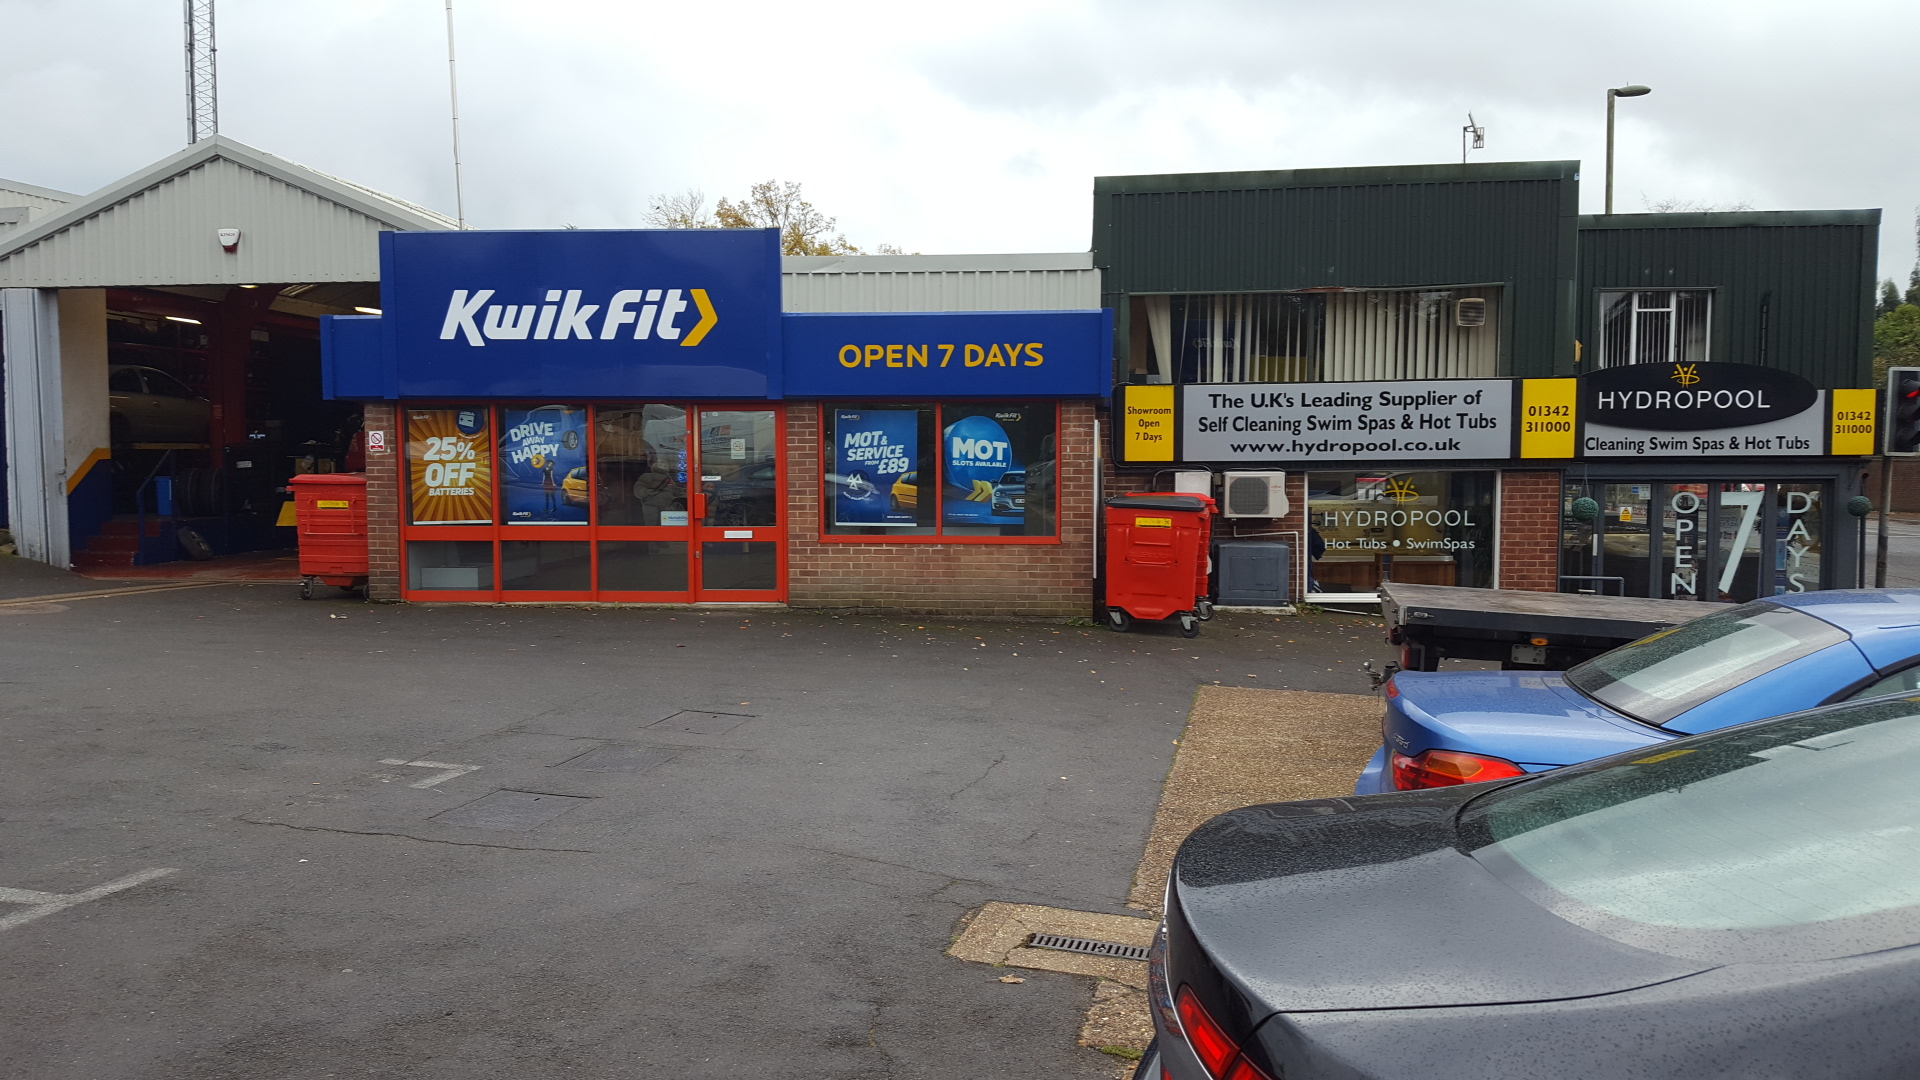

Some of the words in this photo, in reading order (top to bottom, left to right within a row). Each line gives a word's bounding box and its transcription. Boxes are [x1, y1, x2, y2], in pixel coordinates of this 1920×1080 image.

[440, 290, 600, 346] Kwik
[600, 289, 688, 340] Fit
[838, 344, 928, 368] OPEN
[937, 344, 955, 368] 7
[964, 343, 1044, 367] DAYS
[1208, 393, 1244, 409] The
[1250, 392, 1295, 408] U.K's
[1301, 391, 1373, 411] Leading
[1379, 390, 1458, 411] Supplier
[1463, 389, 1483, 405] of
[1598, 389, 1771, 410] HYDROPOOL
[1127, 406, 1172, 415] Showroom
[1528, 405, 1570, 417] 01342
[1837, 411, 1871, 421] 01342
[509, 421, 554, 442] DRIVE
[1138, 418, 1160, 430] Open
[1198, 416, 1229, 432] Self
[1232, 415, 1302, 436] Cleaning
[1306, 414, 1352, 431] Swim
[1357, 414, 1396, 435] Spas
[1400, 413, 1414, 430] &
[1419, 413, 1451, 430] Hot
[1456, 412, 1497, 429] Tubs
[1525, 421, 1571, 433] 311000
[1834, 424, 1873, 434] 311000
[522, 436, 545, 447] AWAY
[844, 430, 883, 448] MOT
[881, 435, 888, 445] &
[1135, 432, 1140, 441] 7
[1143, 432, 1163, 443] Days
[1585, 436, 1645, 454] Cleaning
[1649, 436, 1688, 450] Swim
[1692, 436, 1725, 454] Spas
[1728, 435, 1740, 450] &
[1744, 435, 1772, 450] Hot
[1775, 435, 1810, 450] Tubs
[423, 436, 475, 461] 25%
[511, 443, 560, 464] HAPPY
[847, 445, 904, 462] SERVICE
[952, 436, 1008, 460] MOT
[1230, 438, 1461, 456] www.hydropool.co.uk
[877, 457, 909, 475] £89
[952, 459, 974, 467] SLOTS
[974, 460, 1007, 468] AVAILABLE
[424, 462, 476, 487] OFF
[428, 487, 475, 496] BATTERIES
[1324, 510, 1476, 527] HYDROPOOL
[1324, 538, 1351, 549] Hot
[1356, 537, 1387, 549] Tubs
[1406, 537, 1475, 552] SwimSpas
[1671, 492, 1700, 595] OPEN
[1718, 490, 1765, 594] 7
[1785, 492, 1813, 594] DAYS
